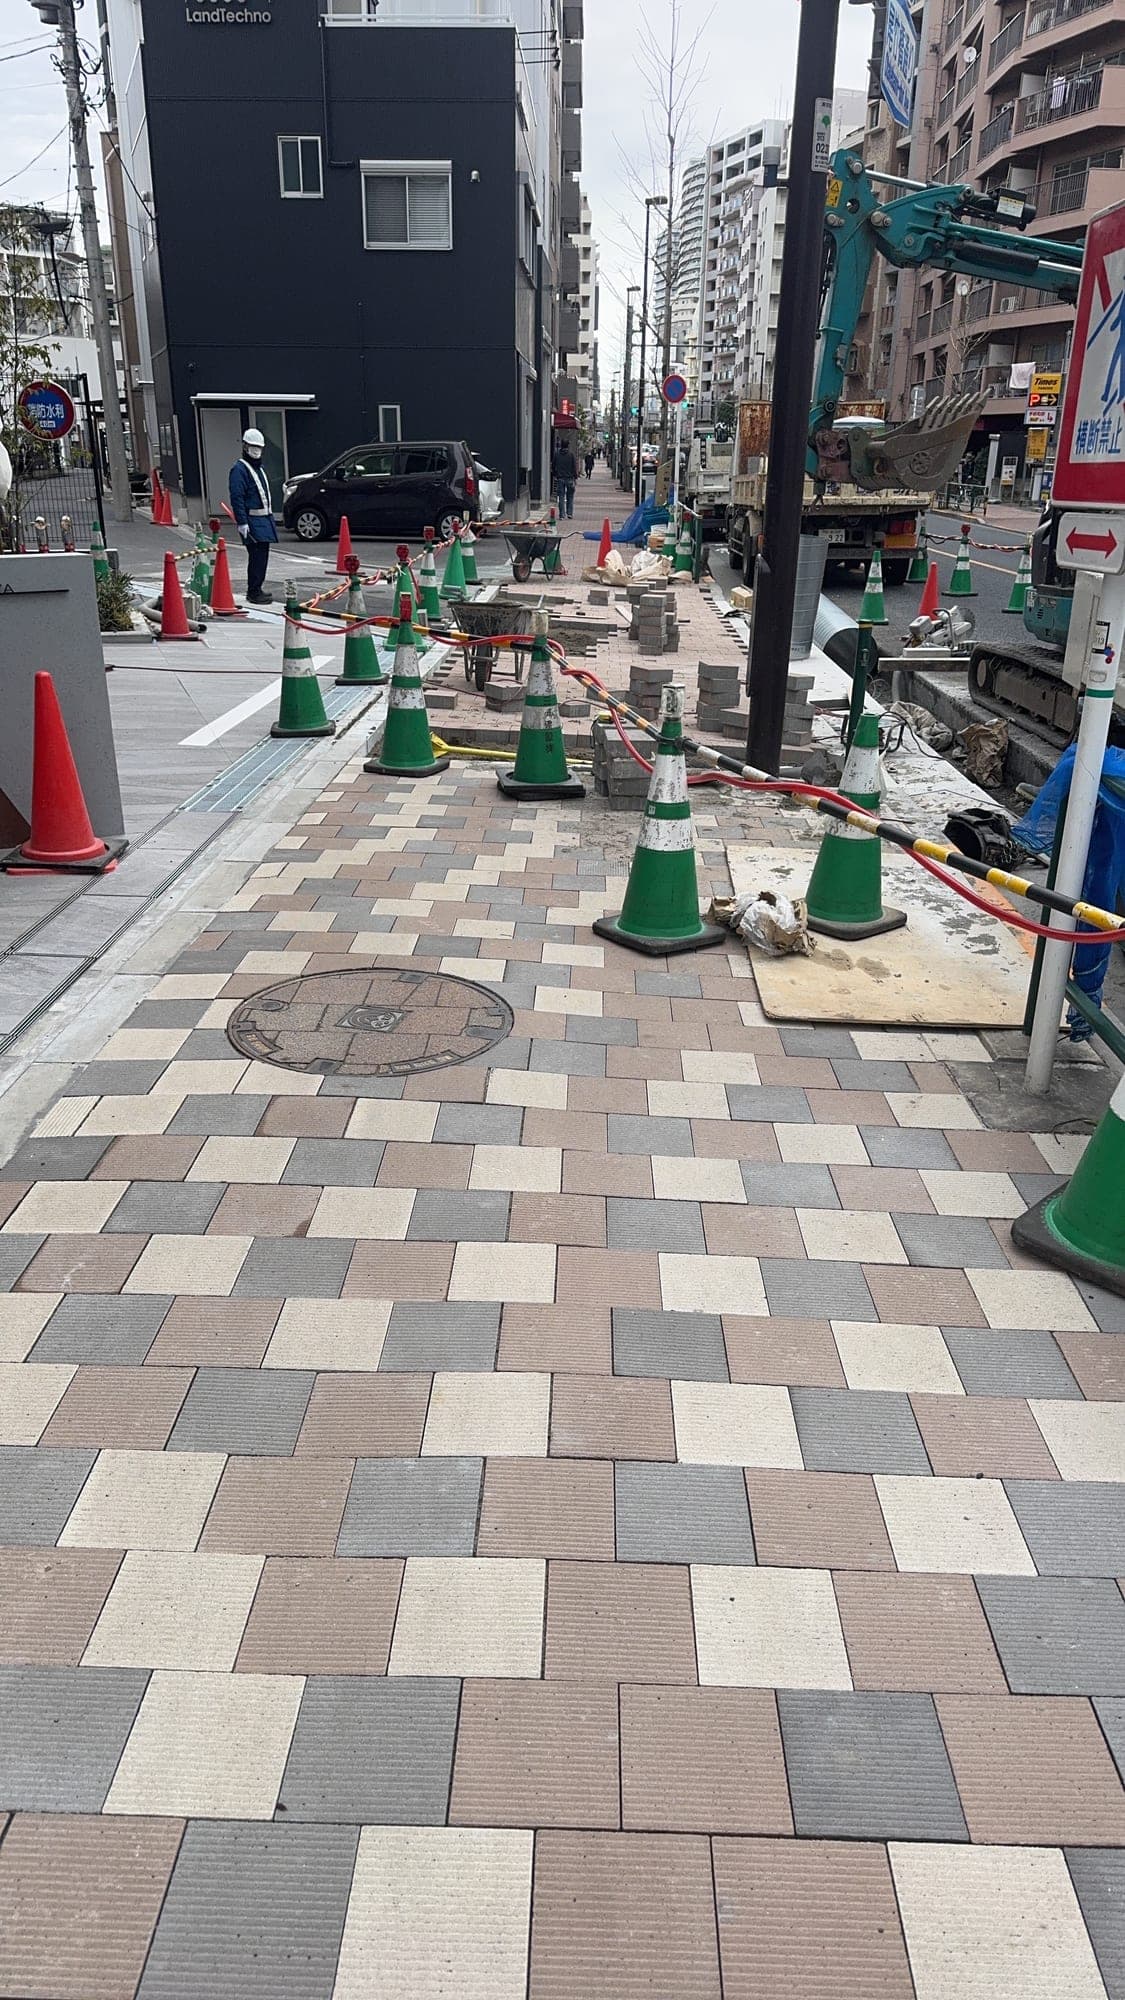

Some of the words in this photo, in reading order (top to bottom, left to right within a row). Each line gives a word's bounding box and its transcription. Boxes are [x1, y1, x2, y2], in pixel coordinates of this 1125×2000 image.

[185, 8, 272, 23] LandTechno
[1034, 378, 1058, 386] Times
[1075, 416, 1122, 455] 横断禁止
